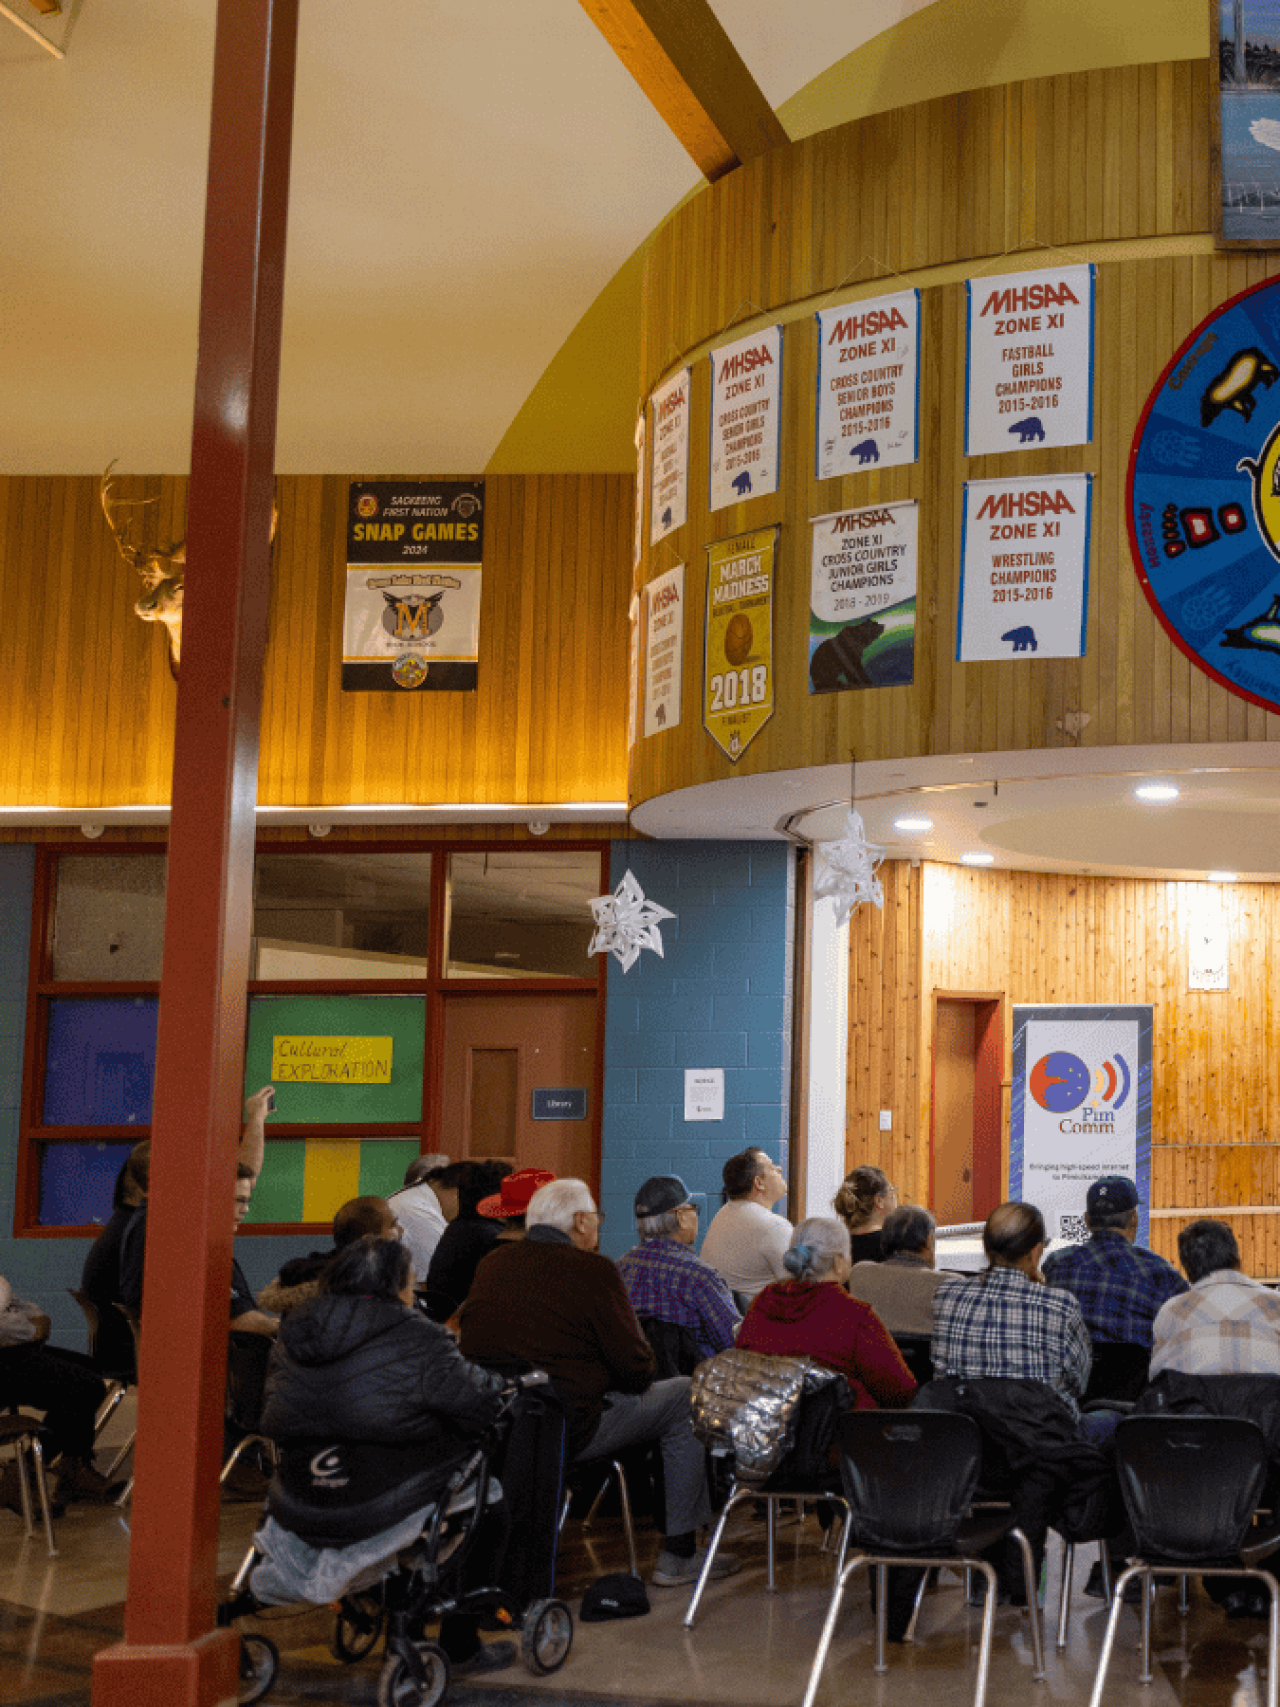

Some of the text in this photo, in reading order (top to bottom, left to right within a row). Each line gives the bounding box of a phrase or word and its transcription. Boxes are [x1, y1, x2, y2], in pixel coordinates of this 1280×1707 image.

[980, 282, 1080, 317] MHSAA
[828, 307, 908, 345] MHSAA
[995, 313, 1065, 336] ZONE XI
[838, 337, 895, 362] ZONE XI
[1002, 343, 1055, 362] FASTBALL
[718, 345, 774, 385] MHSAA
[1012, 361, 1044, 378] GIRLS
[726, 374, 765, 400] ZONE XI
[830, 364, 903, 391] CROSS COUNTRY
[995, 377, 1062, 397] CHAMPIONS
[837, 381, 895, 406] SENIOR BOYS
[840, 398, 893, 421] CHAMPIONS
[998, 395, 1058, 414] 2015-2016
[842, 415, 890, 438] 2015-2016
[976, 490, 1076, 520] MHSAA
[831, 508, 895, 534] MHSAA
[354, 523, 479, 541] SNAP GAMES
[842, 534, 882, 549] ZONE XI
[990, 522, 1060, 541] ZONE XI
[402, 545, 428, 555] 2024
[822, 545, 907, 567] CROSS COUNTRY
[992, 552, 1054, 568] WRESTLING
[720, 555, 762, 582] MARCH
[828, 560, 898, 580] JUNIOR GIRLS
[990, 569, 1057, 586] CHAMPIONS
[713, 573, 769, 605] MADNESS
[830, 575, 894, 592] CHAMPIONS
[992, 587, 1053, 603] 2015-2016
[711, 665, 767, 711] 2018
[279, 1039, 347, 1057] Cultural
[279, 1060, 387, 1080] EXPLORATION
[547, 1100, 573, 1109] Library
[1083, 1107, 1115, 1121] Pim
[1059, 1119, 1115, 1134] Comm
[1060, 1163, 1100, 1172] high-speed
[1102, 1163, 1130, 1171] internet
